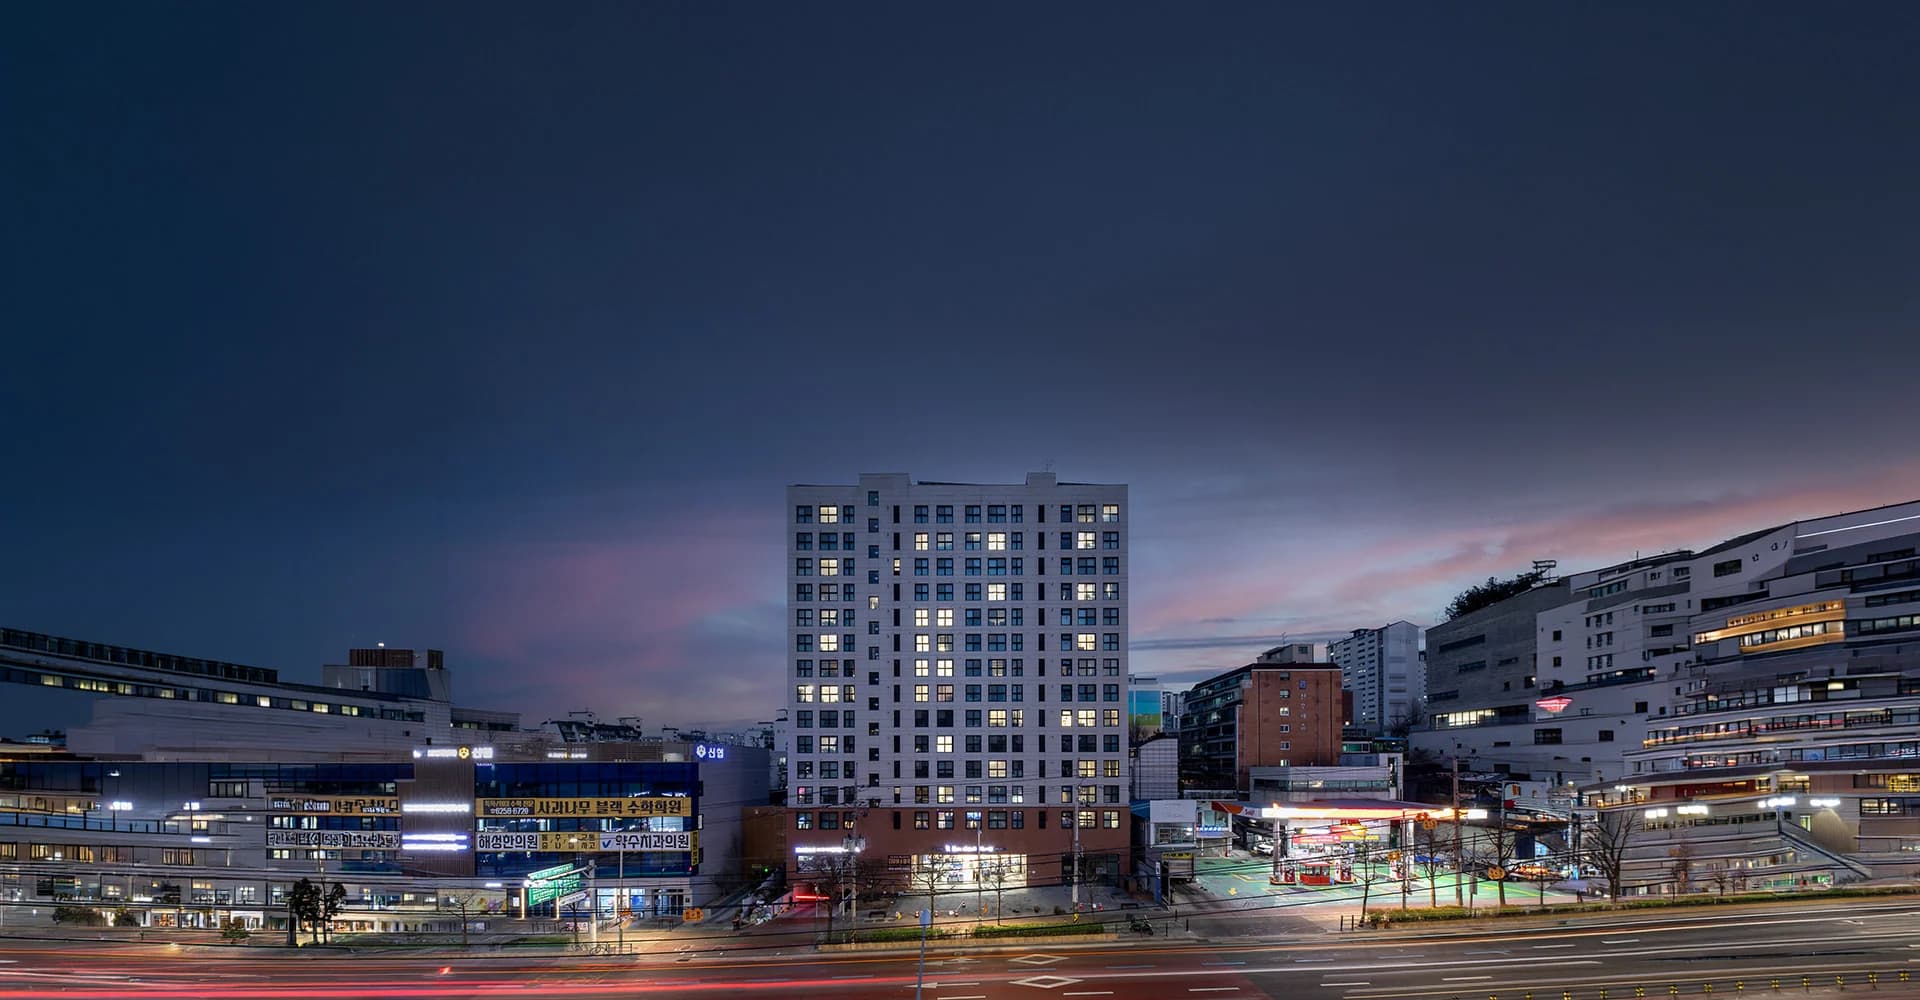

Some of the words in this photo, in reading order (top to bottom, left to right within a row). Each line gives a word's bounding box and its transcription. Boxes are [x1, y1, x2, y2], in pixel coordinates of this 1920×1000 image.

[537, 801, 591, 815] 사과나무
[596, 801, 622, 815] 블랙
[627, 801, 681, 814] 수학학원
[478, 834, 538, 849] 해성한의원
[615, 834, 689, 849] 약수치과의원
